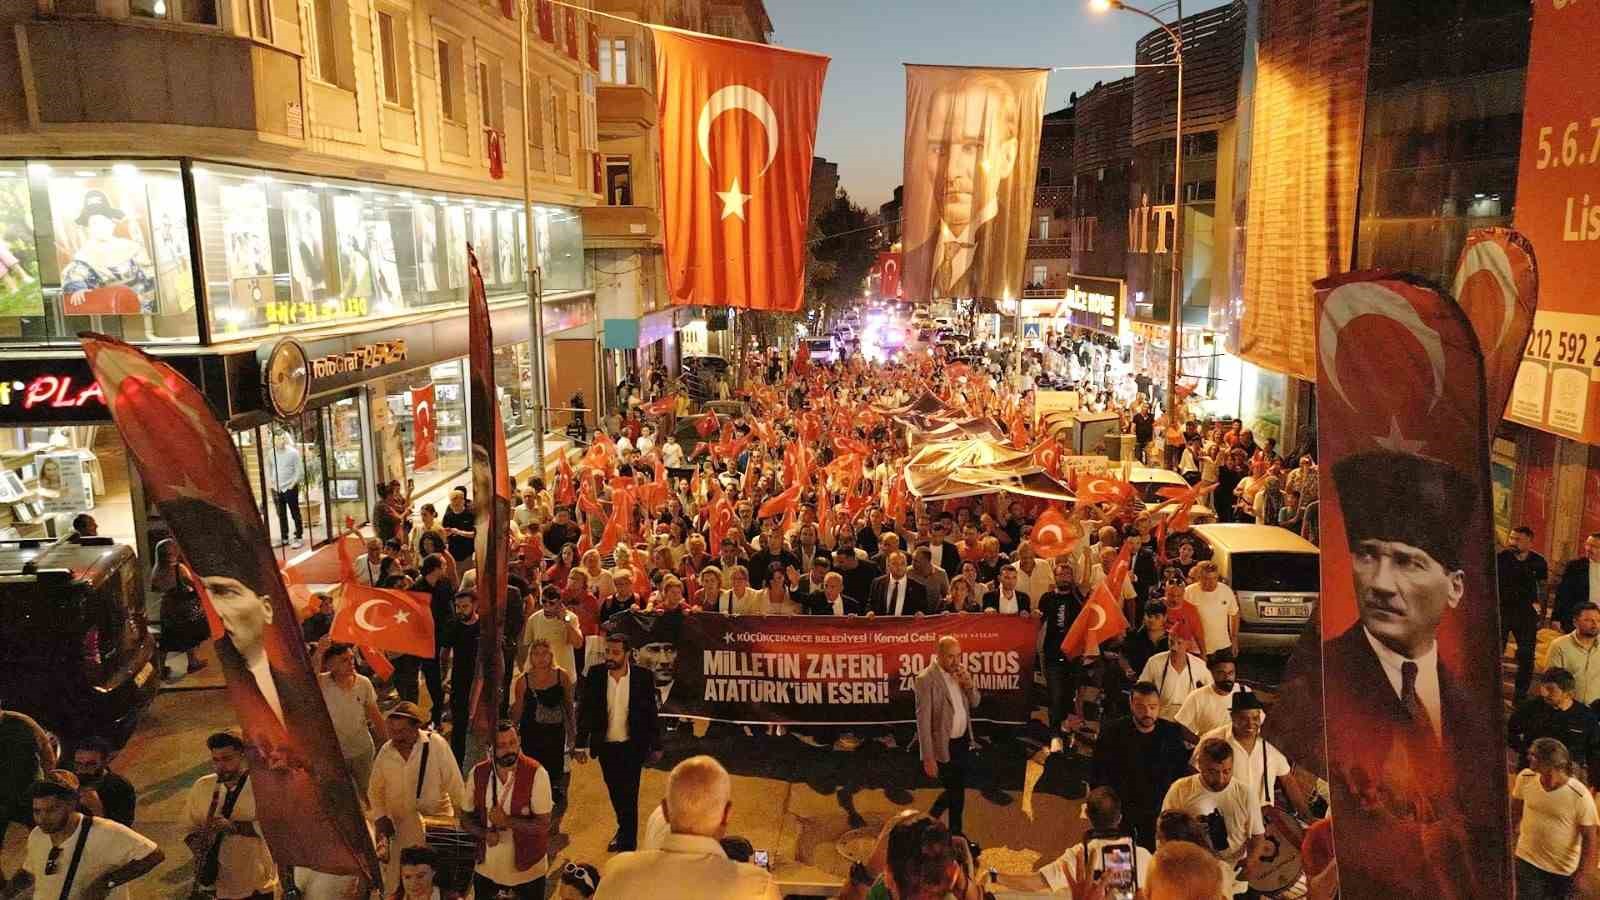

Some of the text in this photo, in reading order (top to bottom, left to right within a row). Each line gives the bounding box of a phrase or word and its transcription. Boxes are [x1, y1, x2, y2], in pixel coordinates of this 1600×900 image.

[1557, 331, 1587, 364] 592
[703, 649, 800, 680] MİLLETİN
[898, 652, 925, 677] 30
